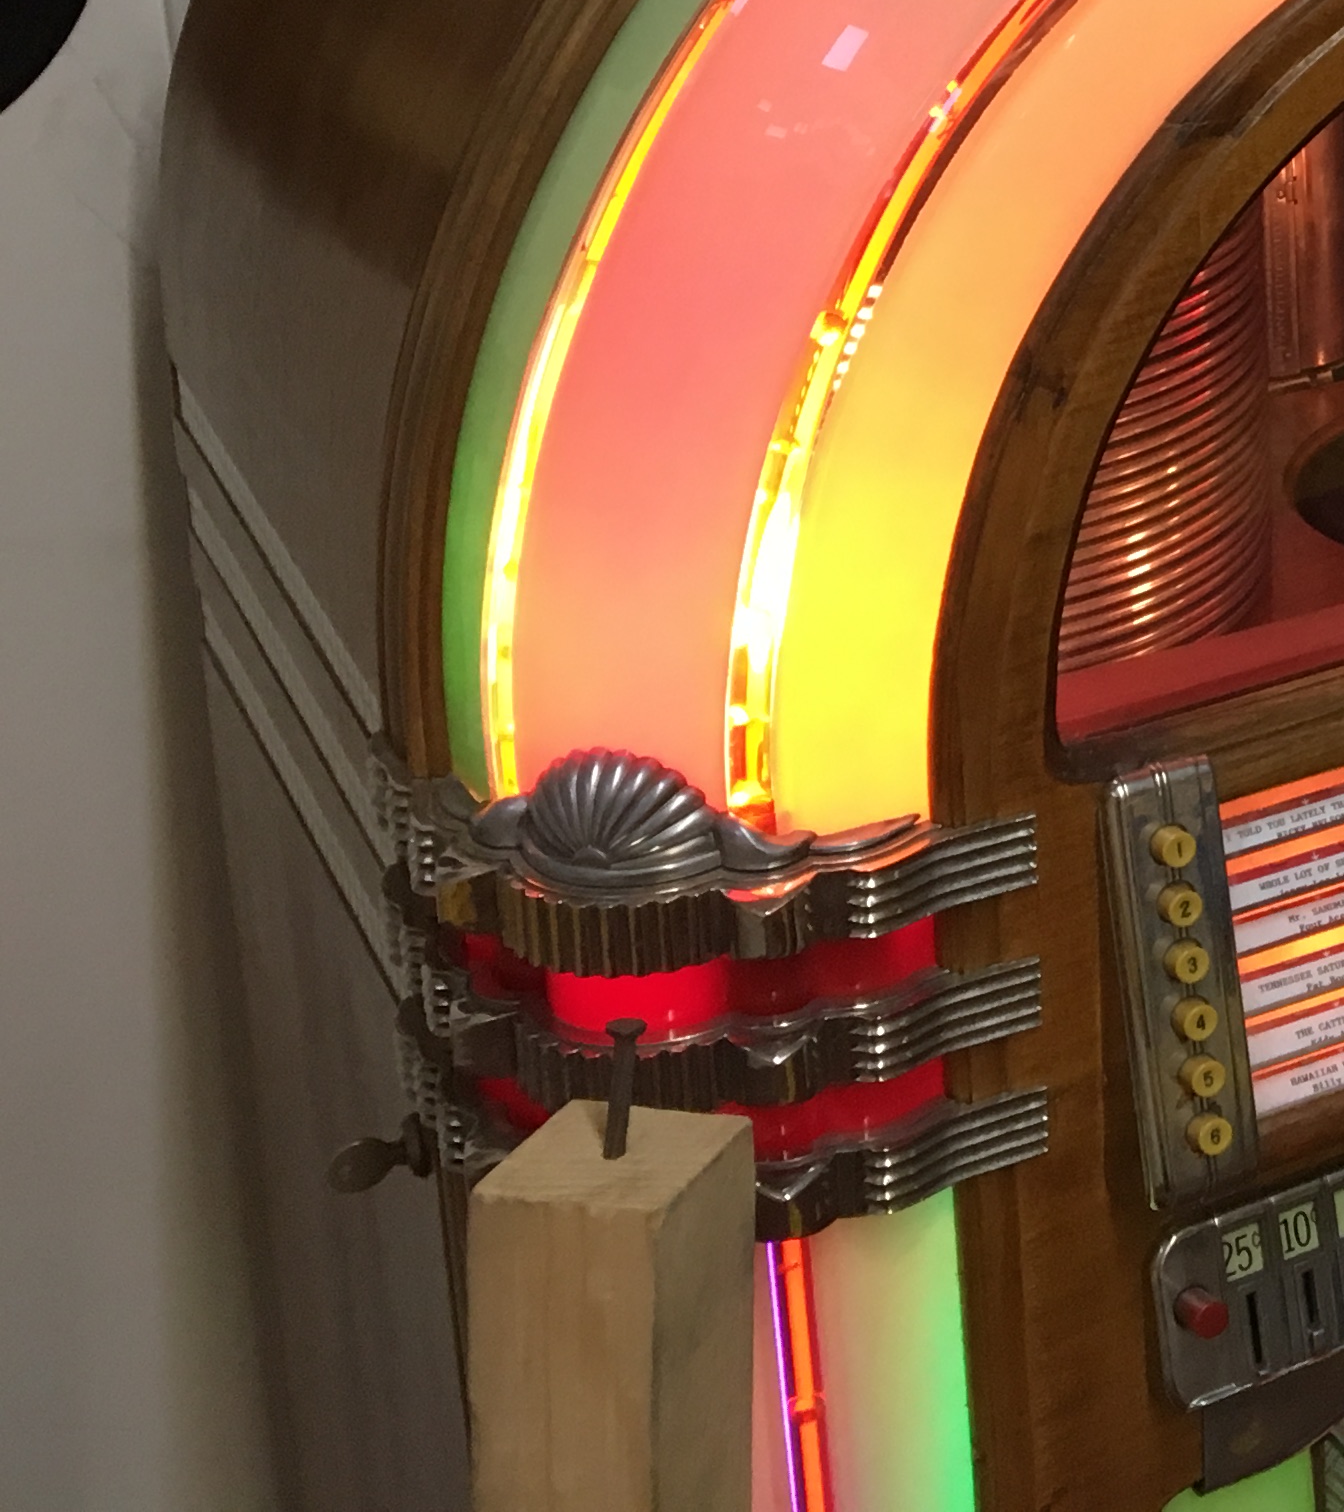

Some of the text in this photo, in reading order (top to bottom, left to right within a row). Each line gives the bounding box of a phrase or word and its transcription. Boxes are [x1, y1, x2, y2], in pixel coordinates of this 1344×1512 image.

[1237, 825, 1262, 839] TOLD
[1266, 819, 1286, 830] YOU
[1290, 806, 1326, 823] LATELY
[1175, 842, 1184, 858] 1
[1258, 877, 1289, 891] WHOLE
[1294, 870, 1314, 881] LOT
[1317, 864, 1330, 874] OF
[1179, 900, 1193, 919] 2
[1288, 914, 1306, 924] Mr.
[1187, 956, 1199, 973] 3
[1258, 971, 1313, 993] TENNESSEE
[1196, 1013, 1207, 1032] 4
[1295, 1028, 1314, 1039] THE
[1203, 1070, 1214, 1087] 5
[1290, 1064, 1338, 1087] HAWAIIAN
[1210, 1128, 1221, 1145] 6
